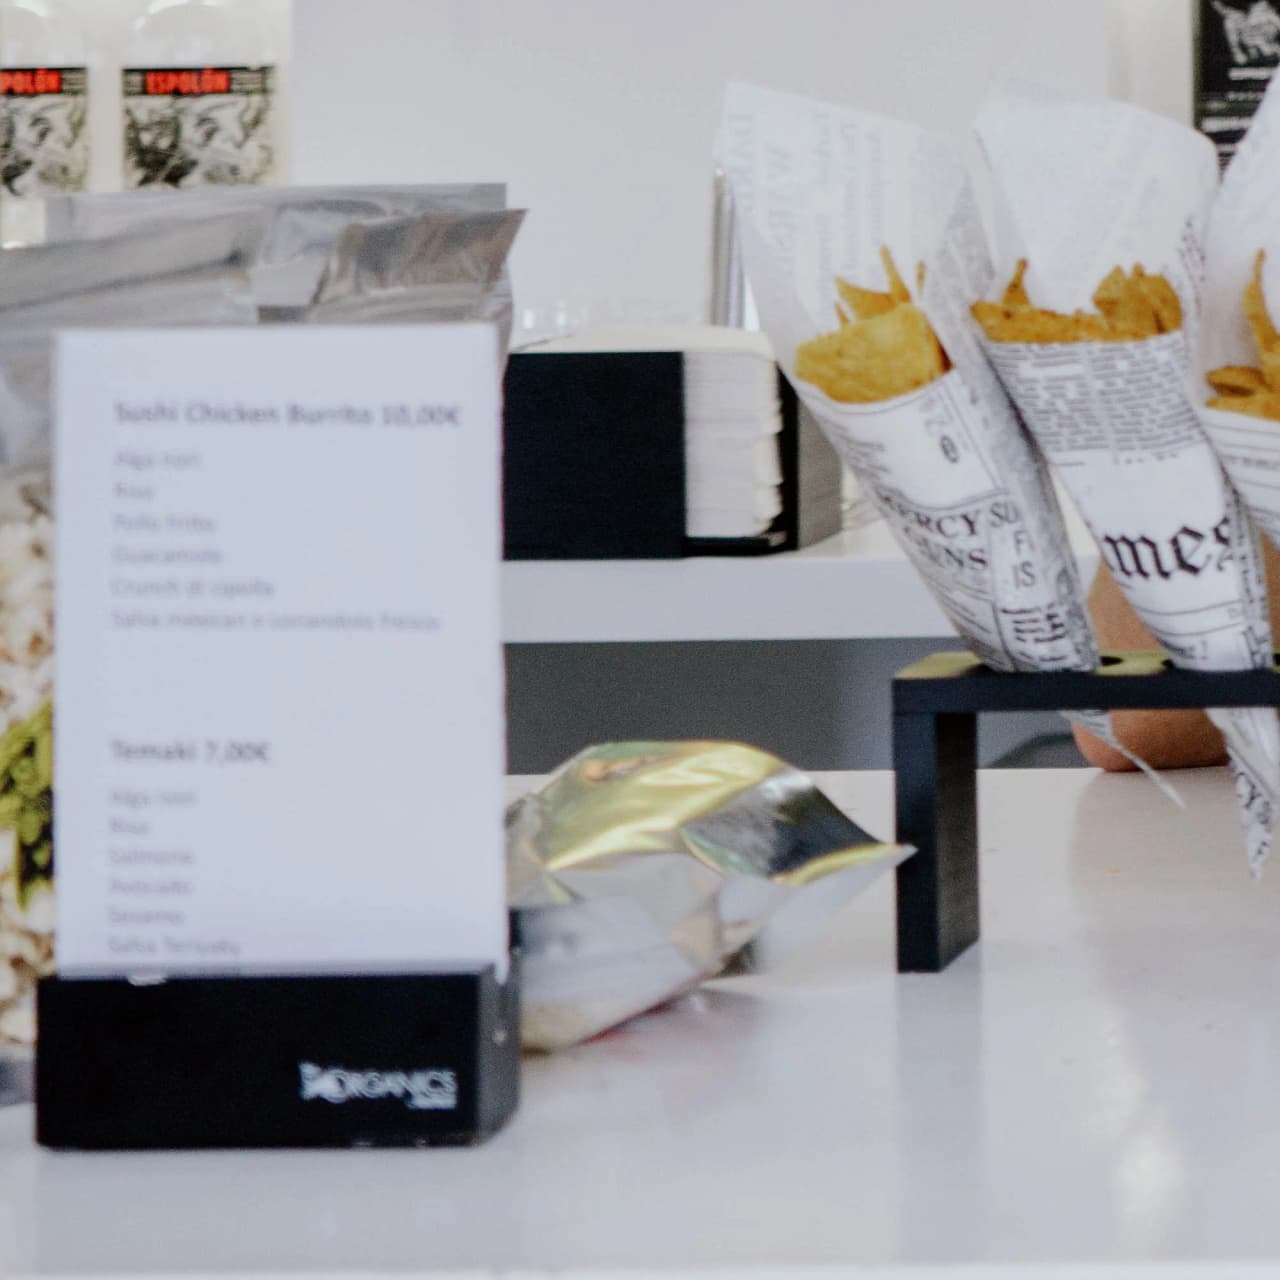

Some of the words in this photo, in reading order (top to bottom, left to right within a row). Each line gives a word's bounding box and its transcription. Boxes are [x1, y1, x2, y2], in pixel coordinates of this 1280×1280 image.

[113, 401, 179, 426] Sushi
[185, 401, 280, 426] Chicken
[286, 402, 374, 426] Burrito
[1103, 513, 1236, 581] mes
[111, 740, 197, 762] Temaki
